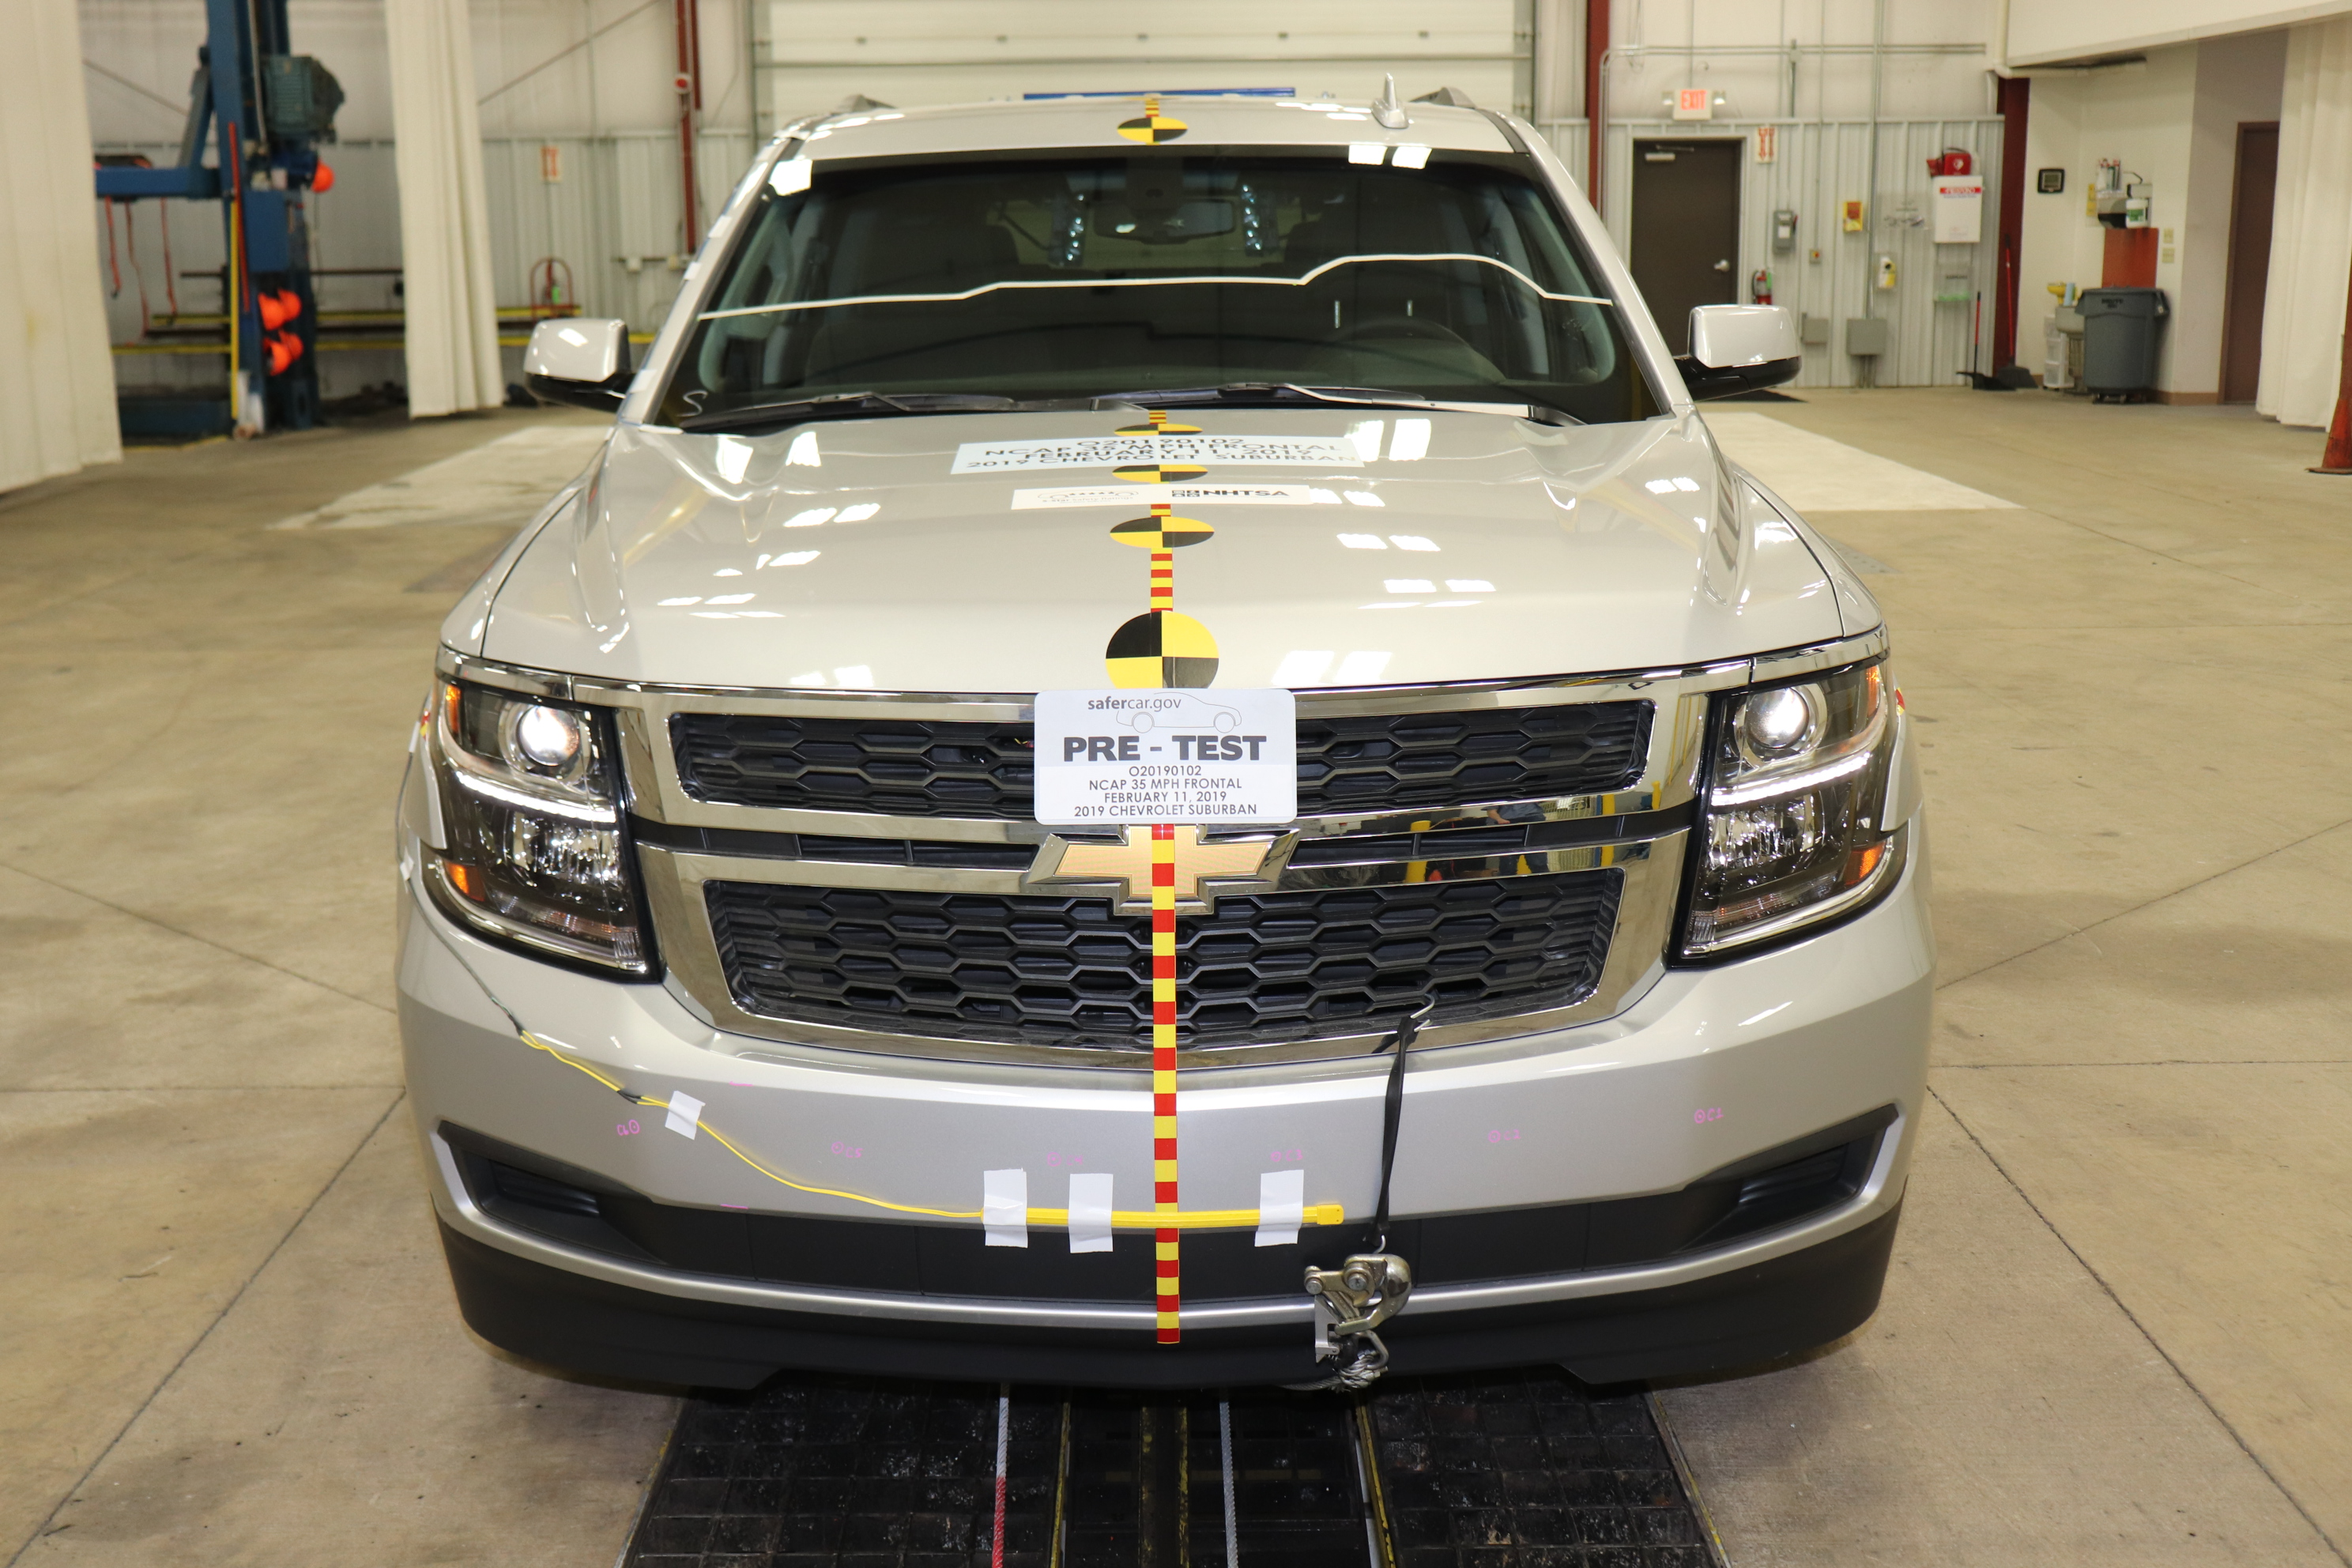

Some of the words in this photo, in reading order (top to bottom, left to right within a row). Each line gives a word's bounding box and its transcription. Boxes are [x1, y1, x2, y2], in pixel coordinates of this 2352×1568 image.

[1681, 89, 1707, 110] EXIT
[986, 447, 1071, 456] NCAP
[1025, 449, 1176, 459] FEBRUARY
[1039, 455, 1197, 464] CHEVROLET
[1088, 696, 1182, 712] safercar.gov
[1064, 736, 1140, 762] PRE
[1172, 735, 1267, 761] TEST
[1089, 779, 1127, 790] NCAP
[1131, 779, 1146, 790] 35
[1151, 778, 1179, 790] MPH
[1185, 778, 1242, 789] FRONTAL
[1105, 792, 1168, 803] FEBRUARY
[1174, 792, 1192, 804] 11,
[1197, 791, 1227, 802] 2019
[1074, 806, 1104, 817] 2019
[1109, 805, 1184, 816] CHEVROLET
[1188, 804, 1257, 815] SUBURBAN
[1707, 1107, 1724, 1121] C1
[1286, 1149, 1303, 1161] C3
